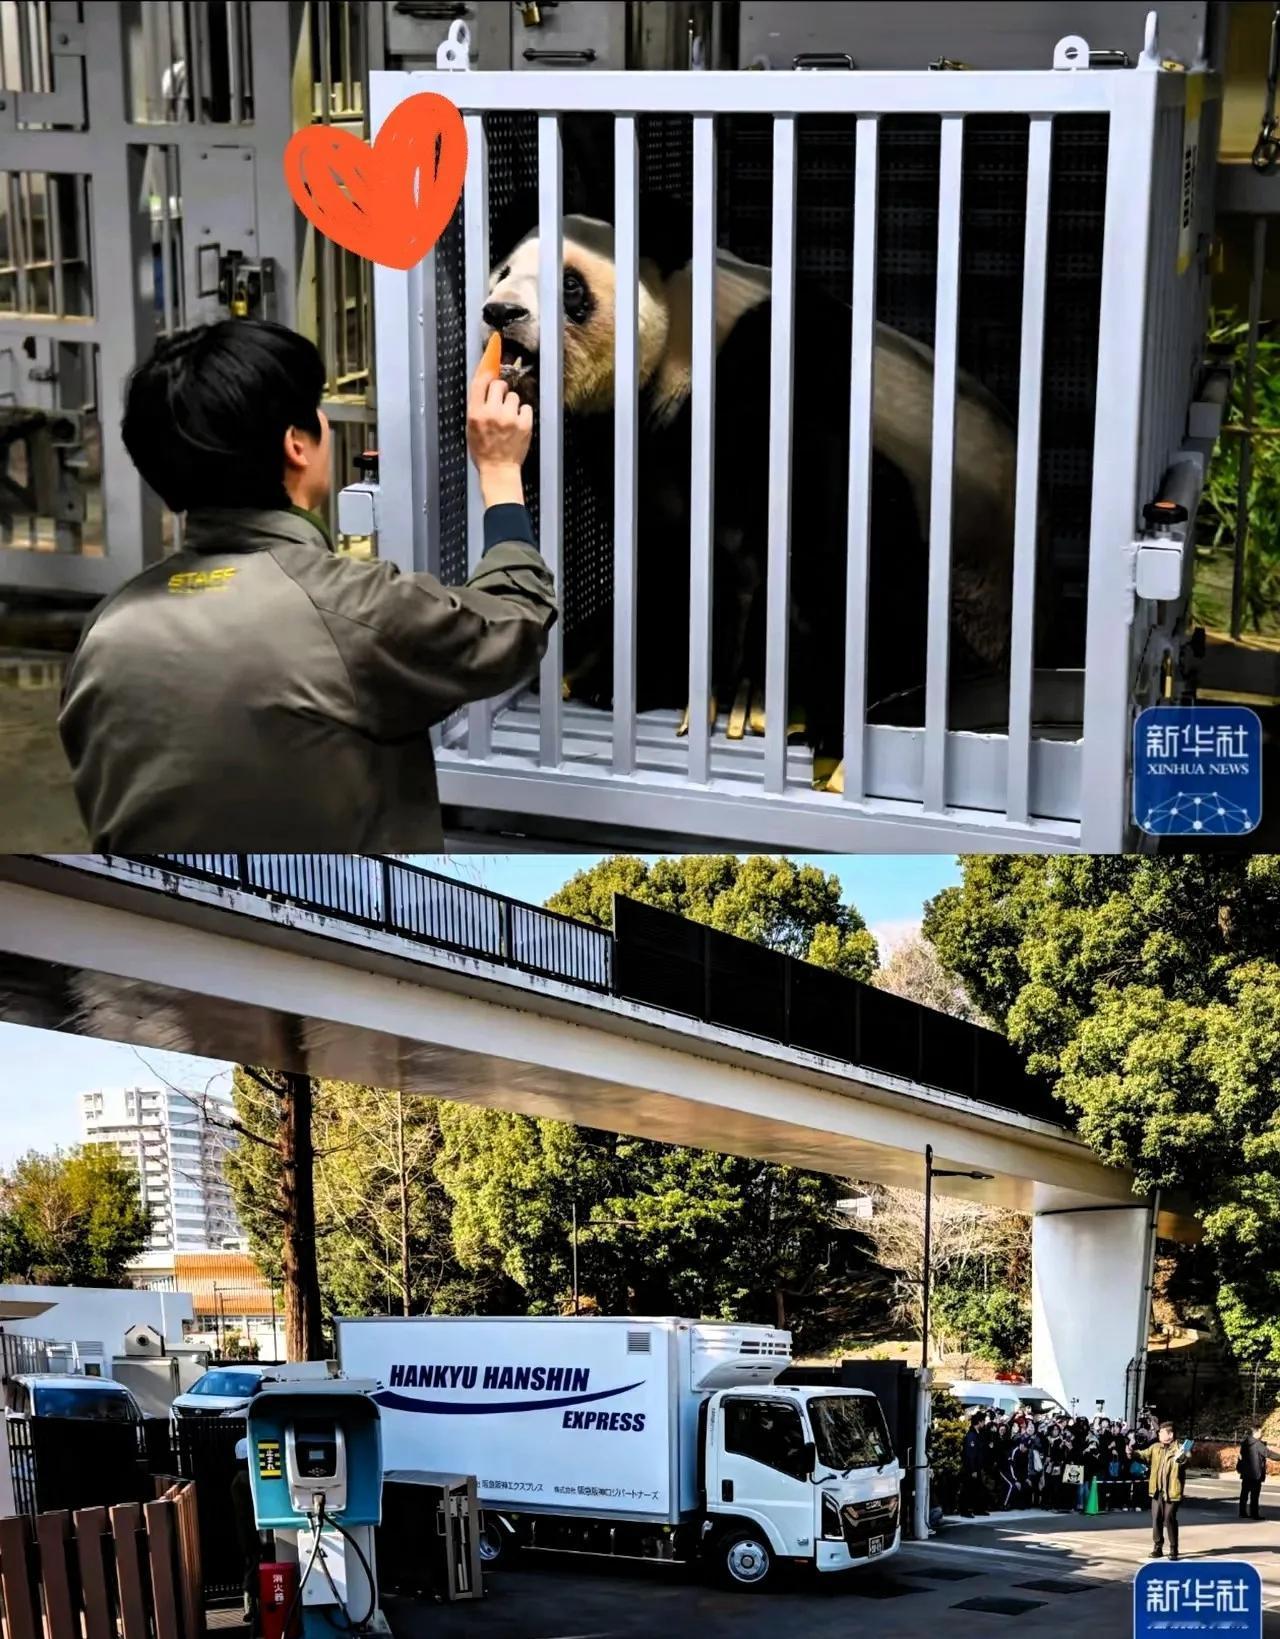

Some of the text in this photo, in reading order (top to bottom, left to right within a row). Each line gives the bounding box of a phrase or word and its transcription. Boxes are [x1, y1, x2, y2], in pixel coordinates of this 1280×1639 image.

[167, 567, 237, 588] STAFF
[389, 1364, 590, 1392] HANKYU HANSHIN
[562, 1410, 646, 1432] EXPRESS
